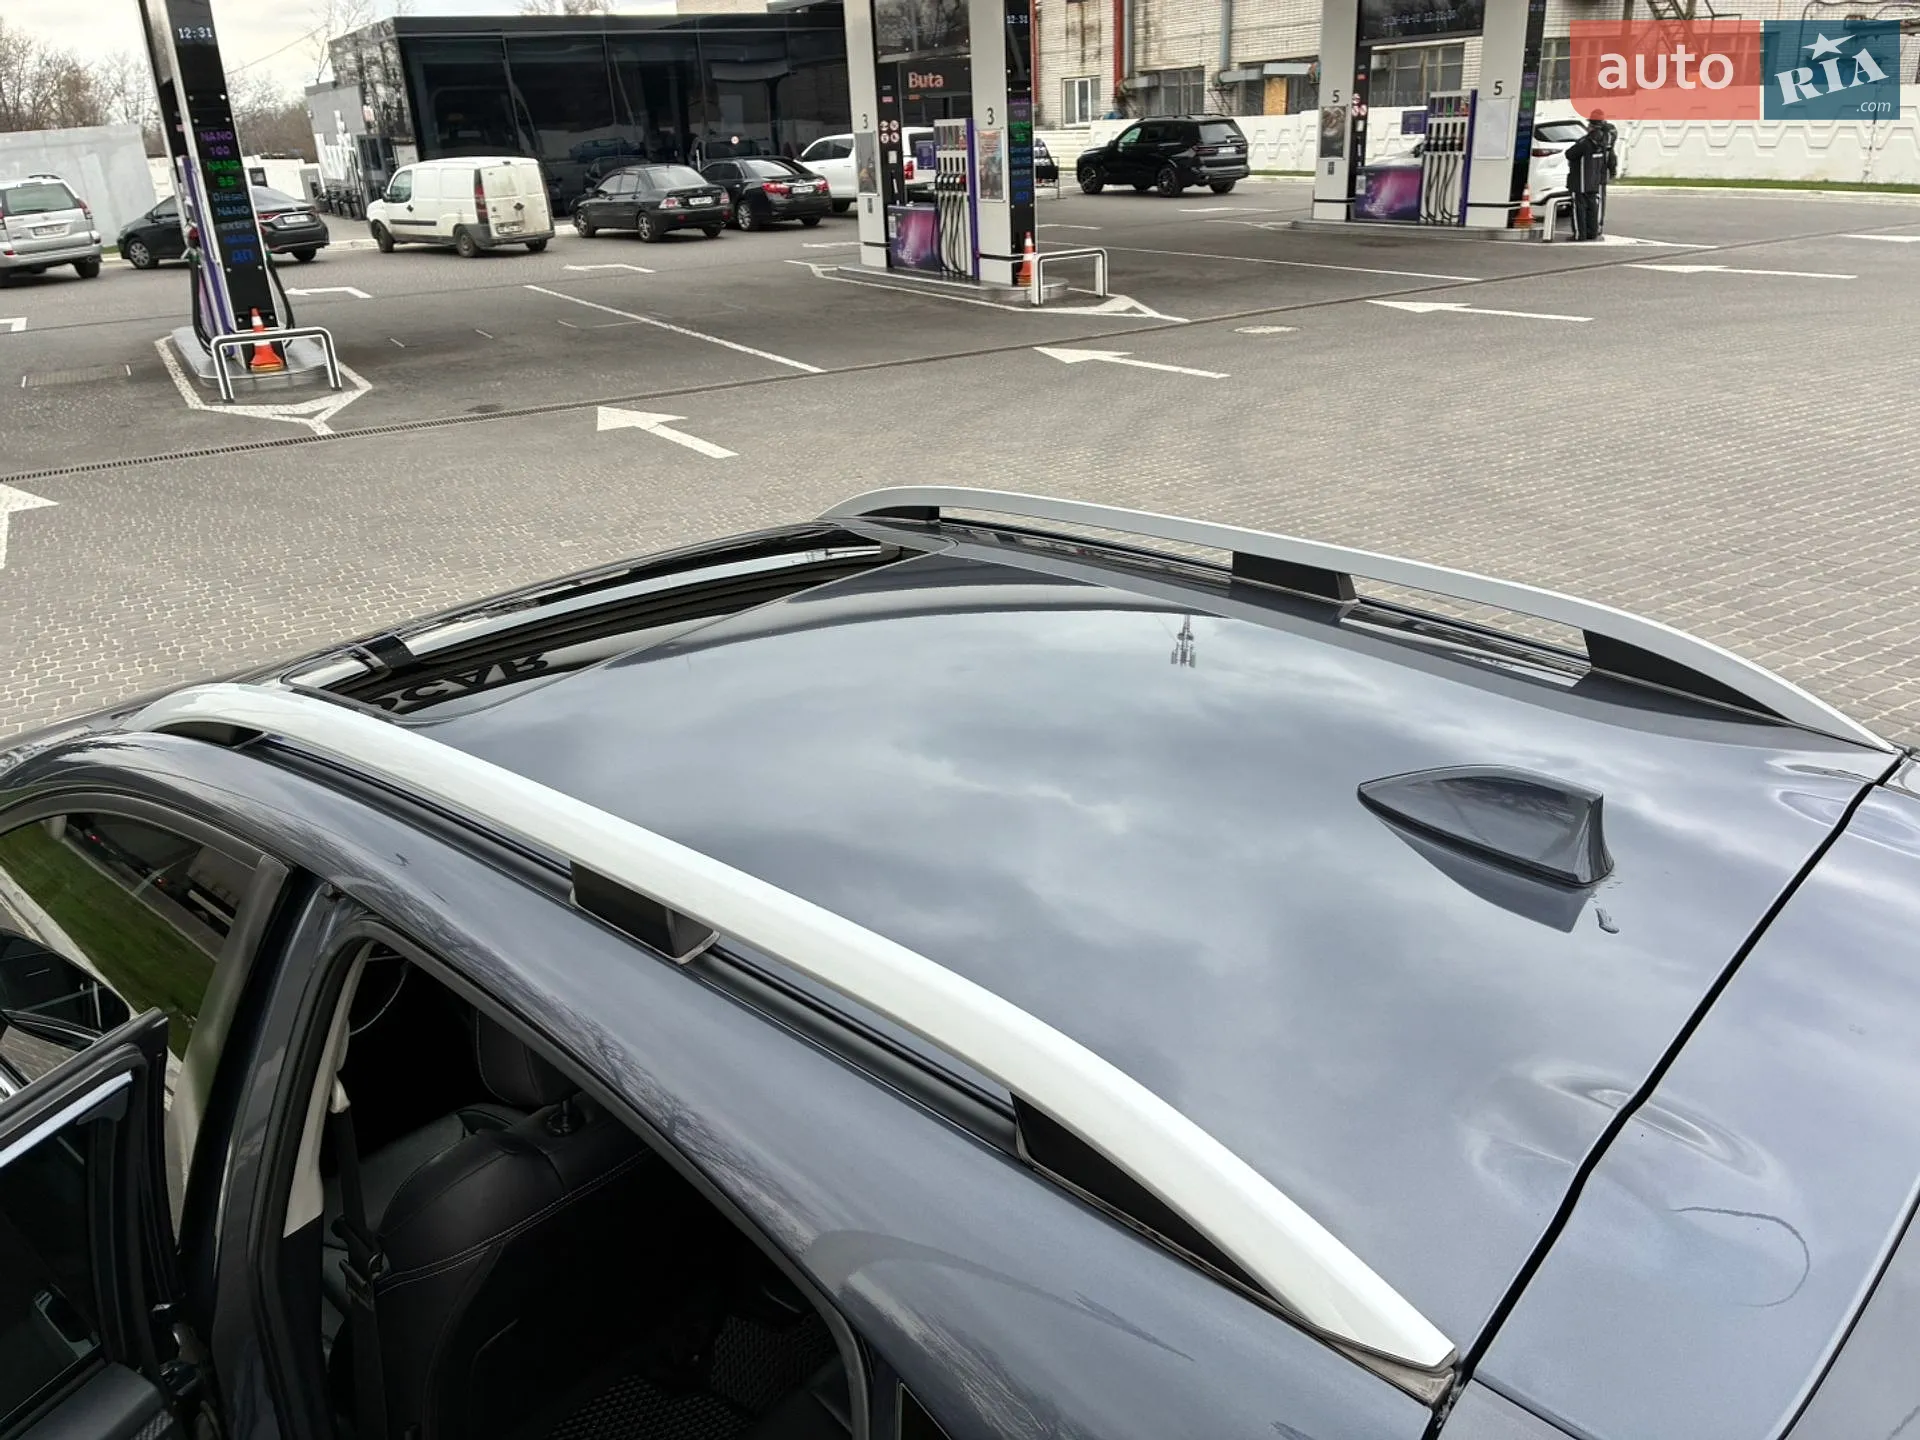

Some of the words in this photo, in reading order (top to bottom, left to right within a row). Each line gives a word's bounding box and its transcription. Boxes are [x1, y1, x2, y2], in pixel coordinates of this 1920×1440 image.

[178, 26, 213, 39] 12:31
[908, 72, 945, 89] Buta
[1493, 80, 1503, 96] 5
[1332, 89, 1340, 103] 5
[862, 113, 869, 129] 3
[987, 107, 995, 126] 3
[200, 130, 234, 141] NANO
[210, 145, 231, 156] 100
[217, 204, 250, 216] NANO
